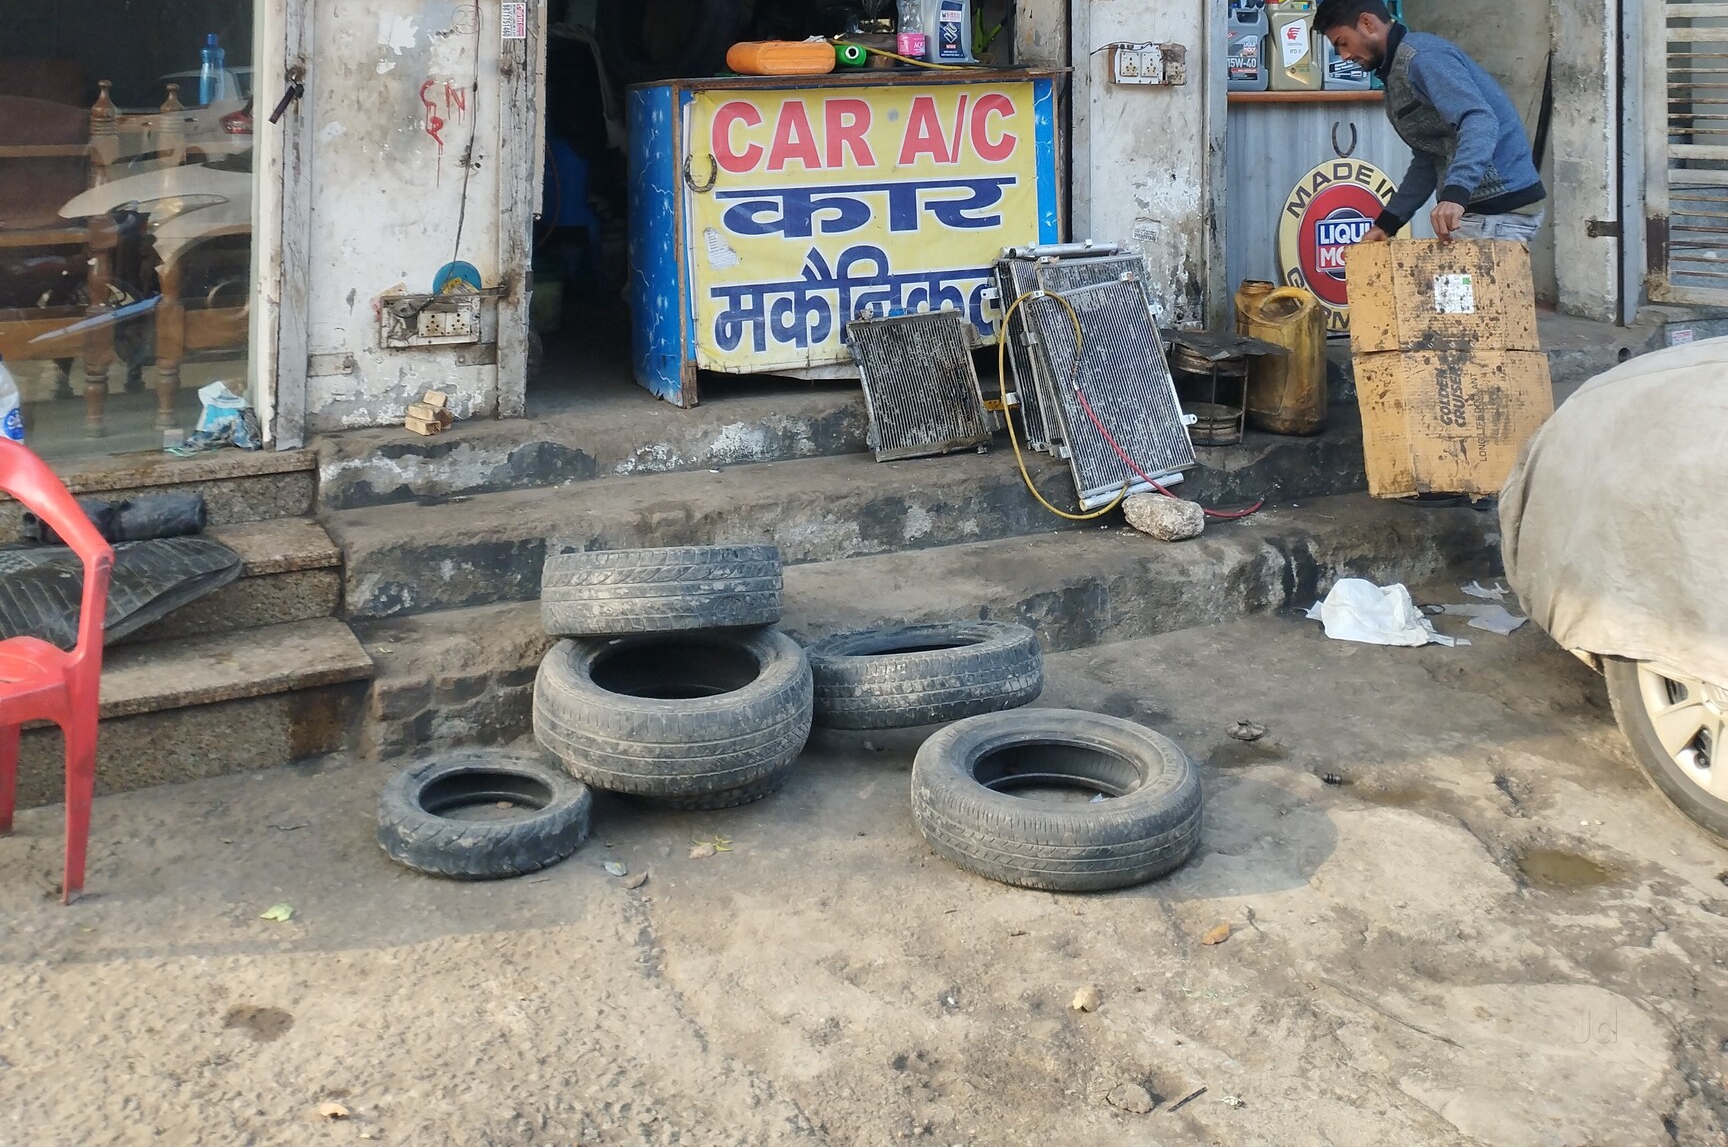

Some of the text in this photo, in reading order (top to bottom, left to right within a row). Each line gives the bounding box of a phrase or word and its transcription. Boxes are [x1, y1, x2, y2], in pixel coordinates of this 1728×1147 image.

[711, 94, 1018, 174] CAR A/C
[715, 176, 1017, 239] कार
[1286, 162, 1375, 220] MADE
[1320, 247, 1347, 267] MO
[1477, 438, 1488, 462] LONG
